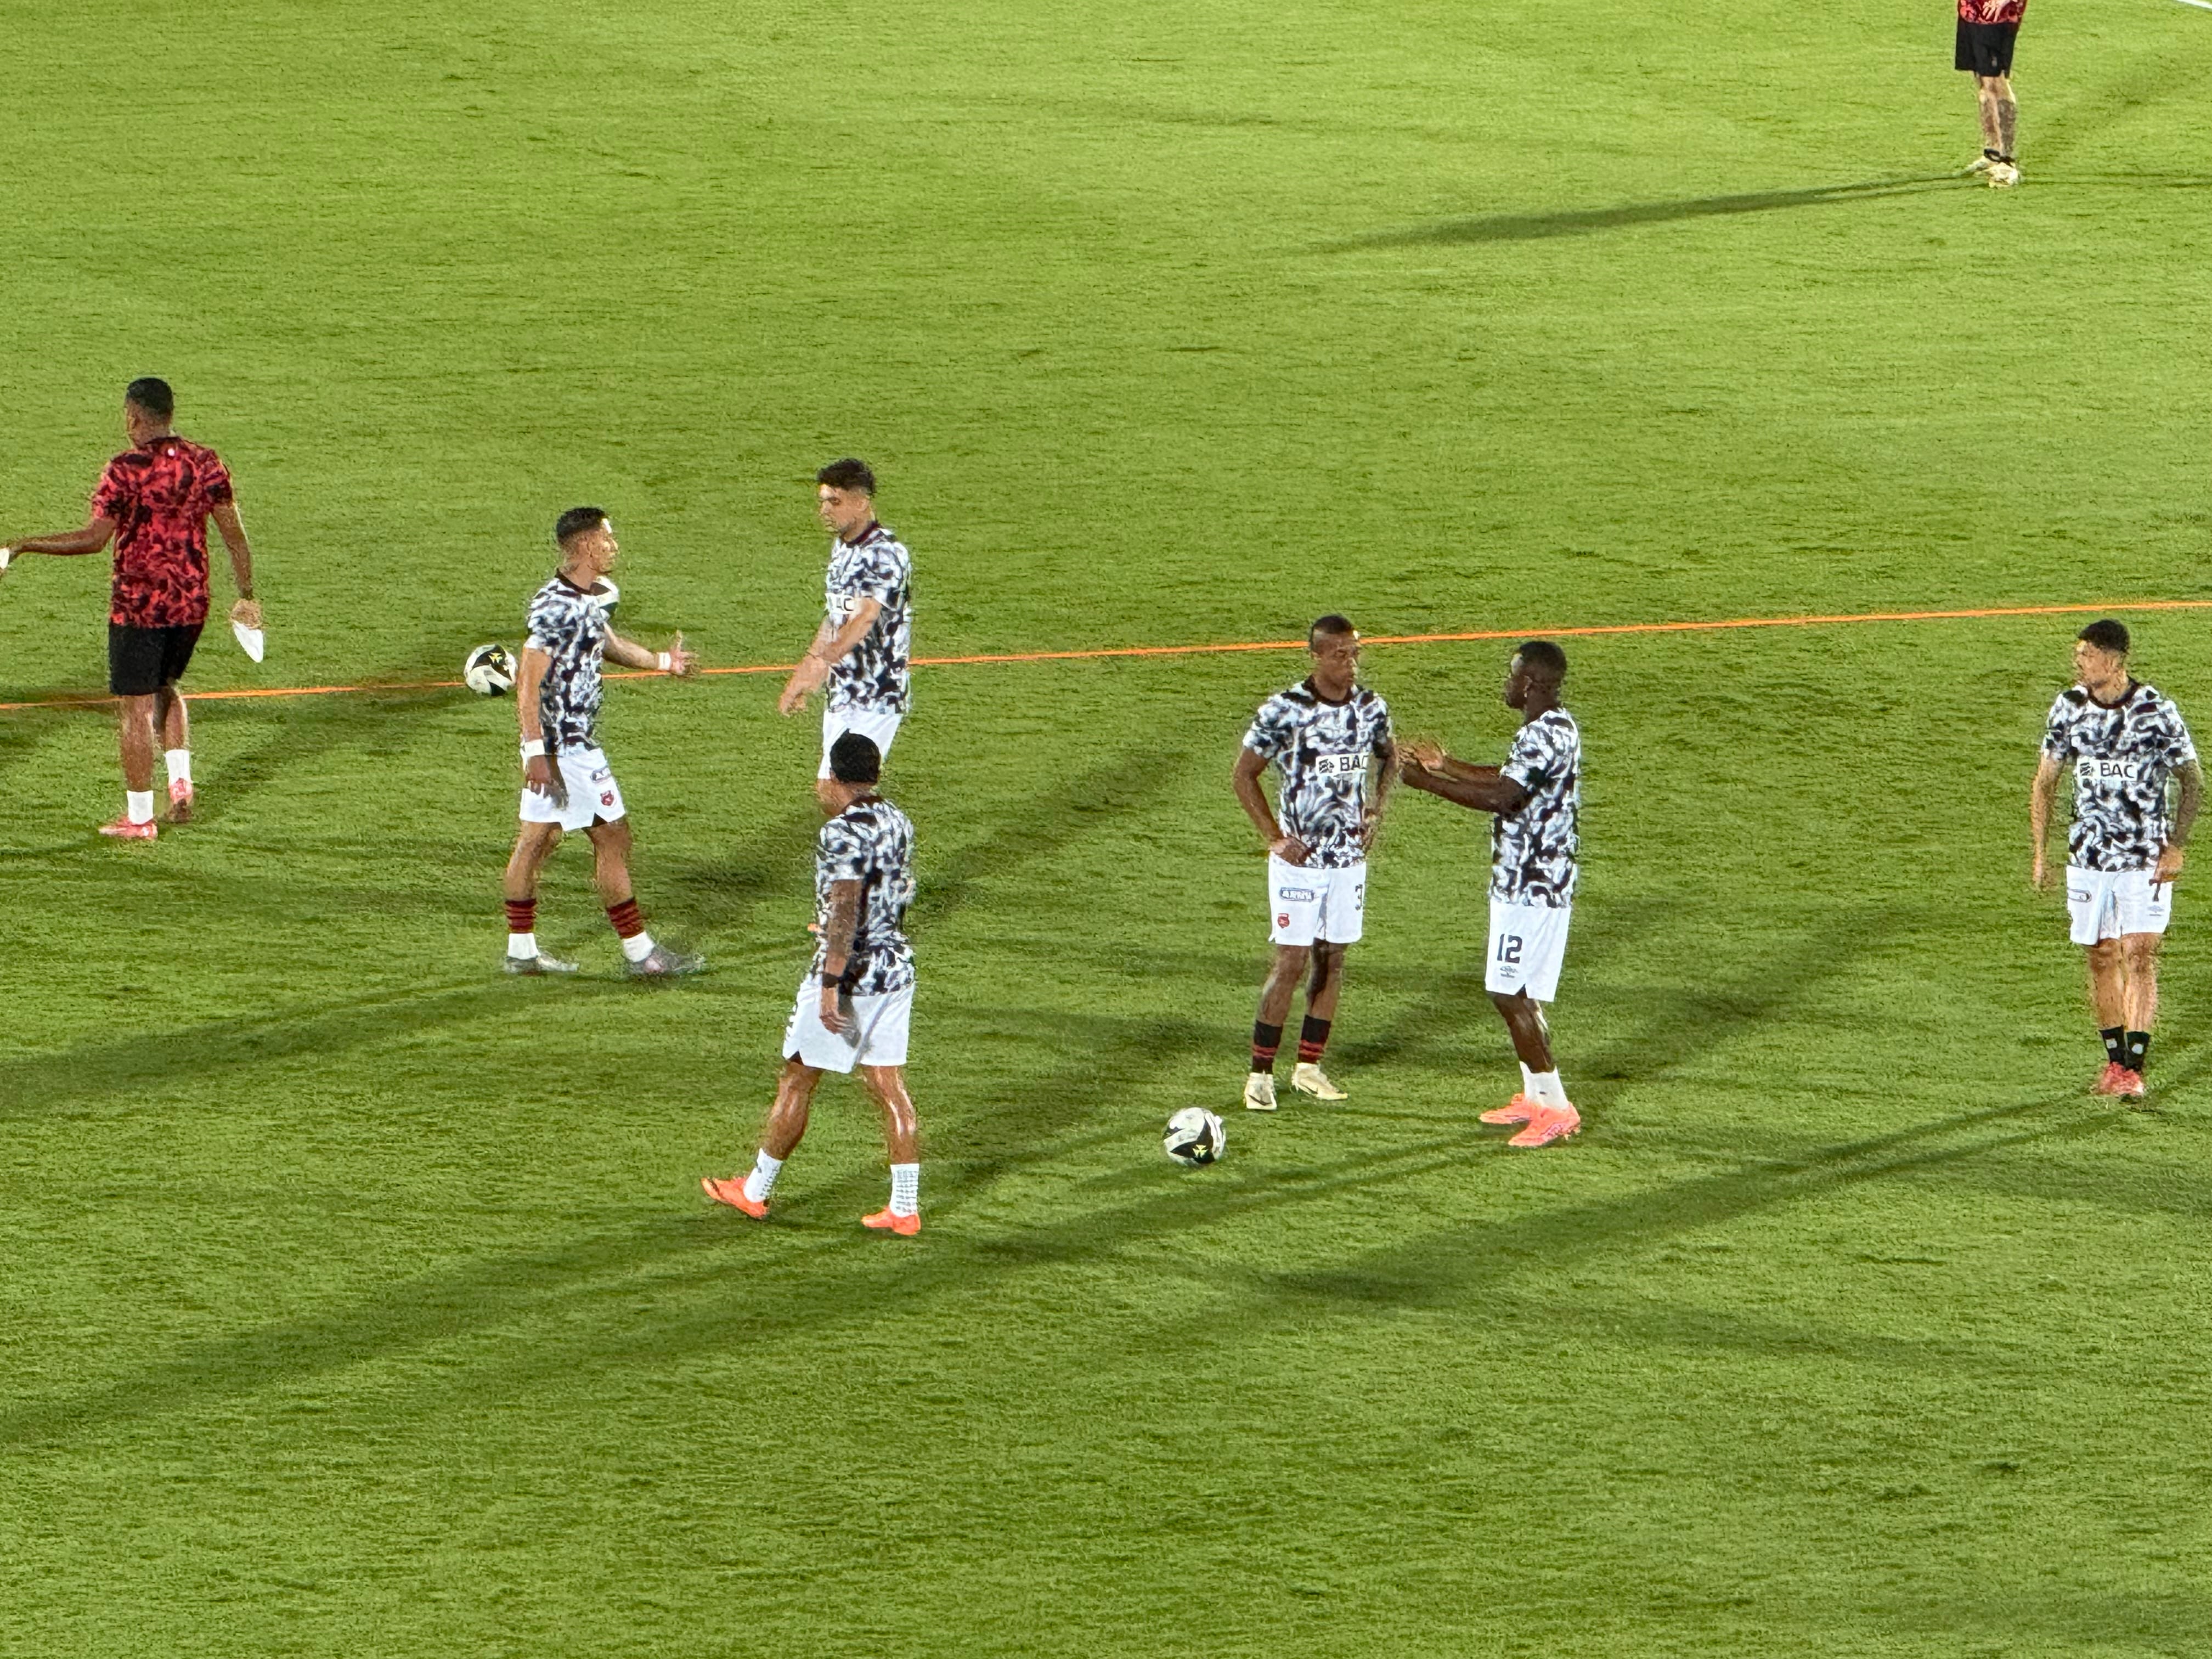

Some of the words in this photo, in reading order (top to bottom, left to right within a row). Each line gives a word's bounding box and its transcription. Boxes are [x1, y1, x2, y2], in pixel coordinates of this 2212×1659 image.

[828, 596, 854, 612] AC
[2100, 762, 2135, 778] BAC
[1497, 933, 1522, 964] 12
